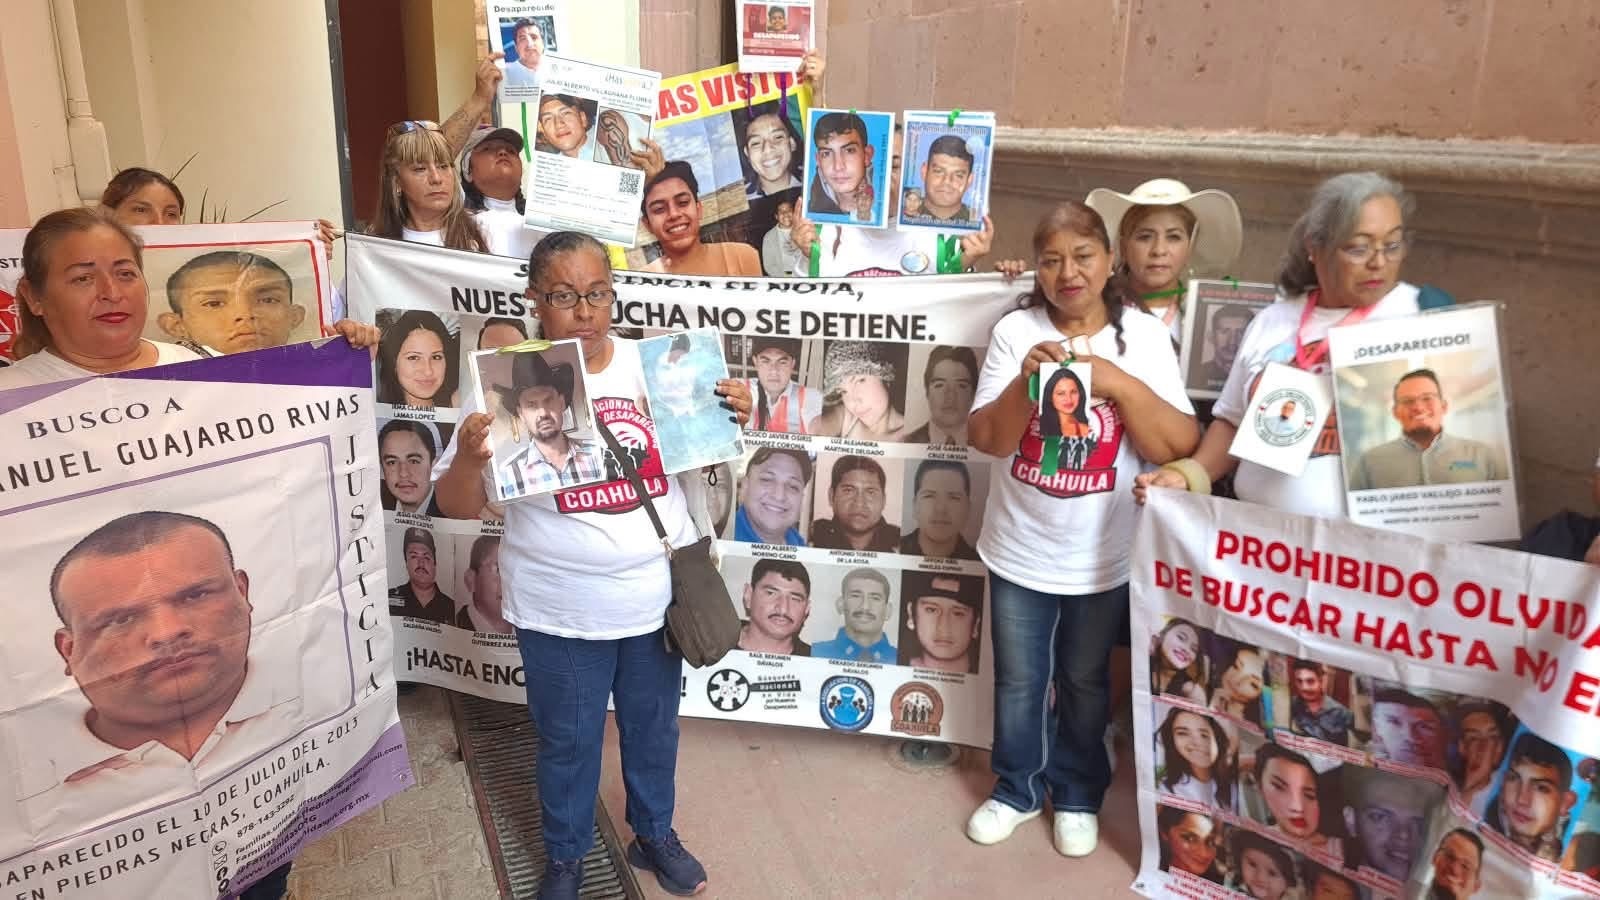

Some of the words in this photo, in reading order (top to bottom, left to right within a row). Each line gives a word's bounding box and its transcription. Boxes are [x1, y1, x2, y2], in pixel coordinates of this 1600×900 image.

[656, 84, 699, 120] AS
[451, 286, 528, 317] NUES
[610, 300, 690, 330] UCHA
[697, 305, 746, 332] NO
[755, 309, 790, 335] SE
[800, 310, 936, 342] DETIENE.
[1354, 333, 1470, 360] ¡DESAPARECIDO!
[24, 402, 150, 441] BUSCO
[163, 397, 185, 415] A
[116, 412, 275, 467] GUAJARDO
[287, 393, 360, 429] RIVAS
[563, 478, 663, 509] COAHULA
[1017, 463, 1108, 492] COAHUILA
[1216, 529, 1440, 607] PROHIBIDO
[407, 646, 478, 681] ¡HASTA
[1154, 560, 1193, 598] DE
[1200, 575, 1343, 639] BUSCAR
[1353, 610, 1499, 672] HASTA
[1513, 645, 1559, 693] NO
[1562, 671, 1600, 719] E
[0, 827, 146, 894] APARECIDO
[157, 816, 182, 835] EL
[193, 802, 212, 823] 10
[217, 786, 239, 807] DE
[244, 755, 287, 794] JULIO
[292, 738, 320, 761] DEL
[326, 716, 359, 745] 2013
[56, 847, 161, 894] PIEDRAS
[253, 756, 331, 810] COAHUILA.
